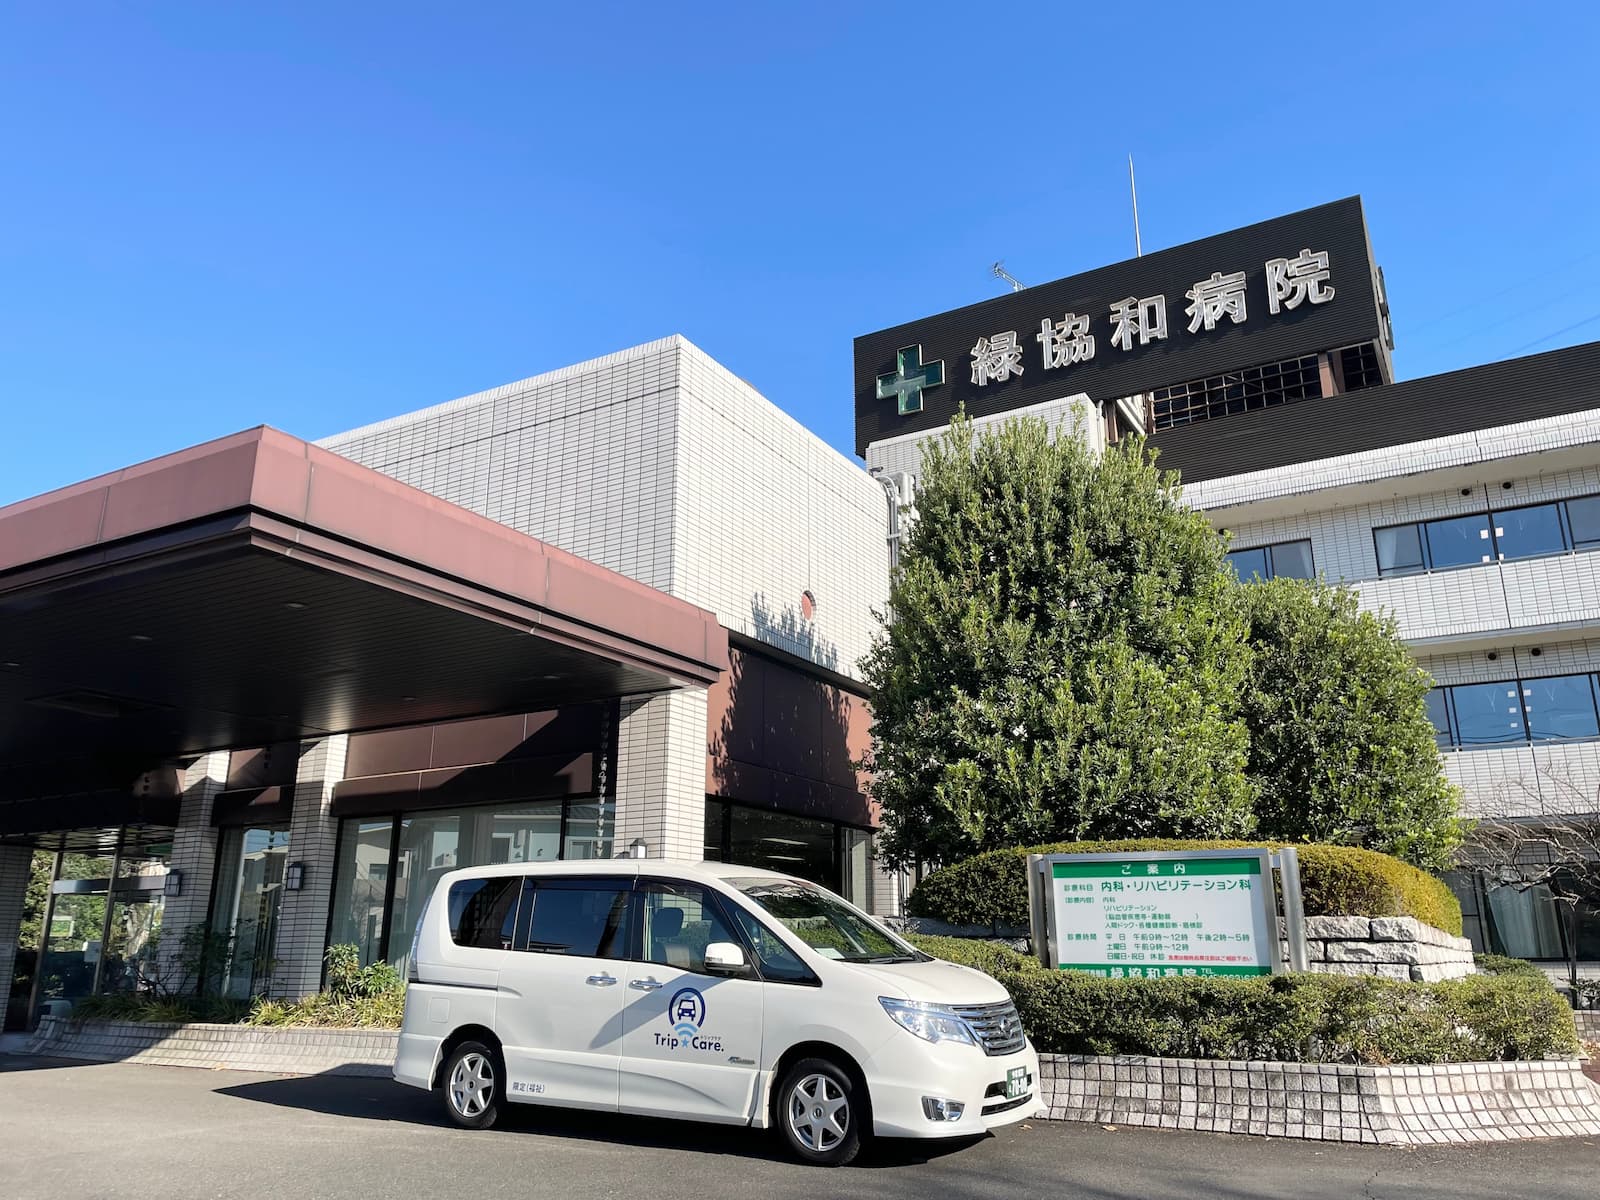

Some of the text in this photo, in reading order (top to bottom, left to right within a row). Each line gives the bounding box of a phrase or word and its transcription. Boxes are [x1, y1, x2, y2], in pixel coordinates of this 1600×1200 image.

[970, 248, 1335, 386] 緑協和病院
[1121, 863, 1186, 875] ご案内
[1063, 879, 1251, 892] 診療科目 内科・リハビリテーション科
[1103, 904, 1157, 912] リハビリテーション
[1106, 943, 1127, 951] 土曜日
[1106, 952, 1145, 960] 日曜日・祝日
[1150, 952, 1165, 961] 休診
[654, 1033, 679, 1050] Trip
[512, 1081, 544, 1094] 限定(福祉)
